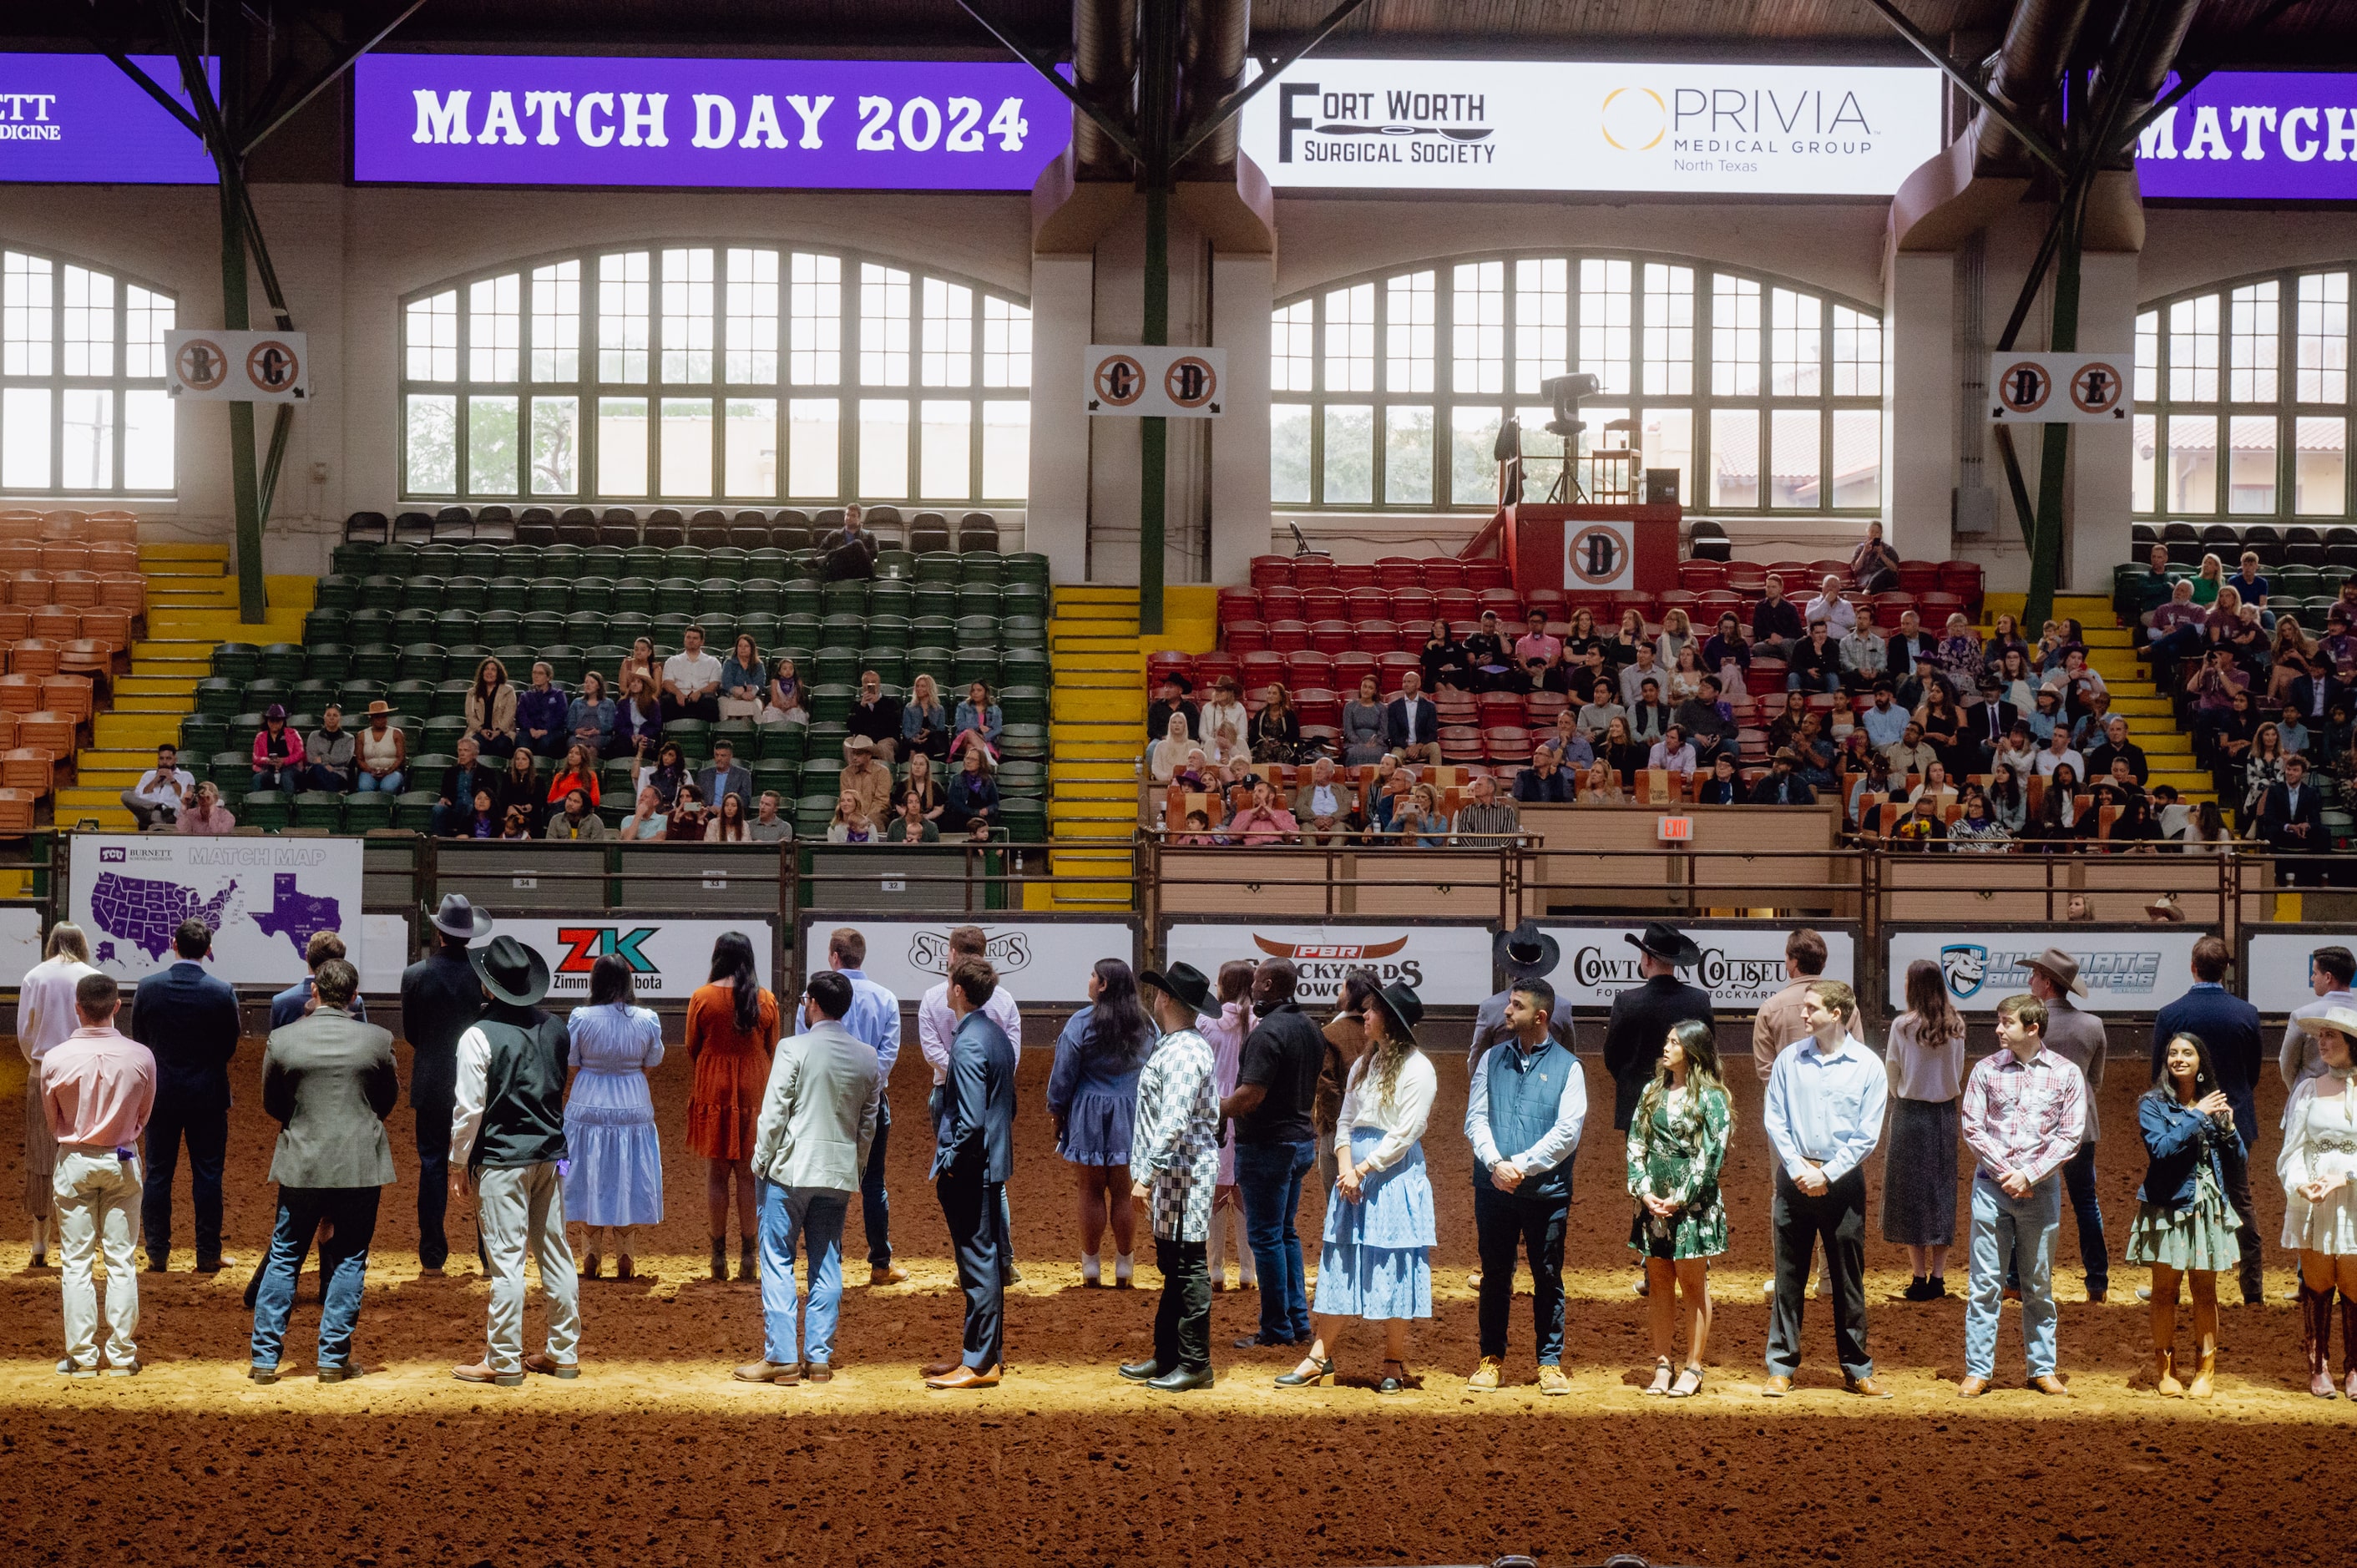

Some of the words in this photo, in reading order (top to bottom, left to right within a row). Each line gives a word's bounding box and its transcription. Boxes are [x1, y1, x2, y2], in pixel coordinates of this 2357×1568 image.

[412, 89, 669, 147] MATCH
[691, 93, 835, 149] DAY
[857, 95, 1029, 152] 2024
[1279, 83, 1374, 163] FORT
[1386, 90, 1485, 121] WORTH
[1675, 89, 1870, 134] PRIVIA
[1304, 140, 1403, 163] SURGICAL
[1411, 141, 1496, 164] SOCIETY
[1674, 139, 1778, 153] MEDICAL
[1792, 140, 1871, 154] GROUP
[1674, 159, 1712, 172] North
[1718, 159, 1758, 172] Texas
[191, 346, 214, 382] B
[264, 349, 284, 385] C
[1110, 362, 1130, 398] C
[1181, 365, 1202, 400] D
[2015, 370, 2038, 405] D
[2086, 372, 2106, 403] E
[1587, 534, 1613, 576] D
[1665, 819, 1688, 837] EXIT
[102, 849, 124, 861] TCU
[189, 847, 270, 866] MATCH
[275, 848, 326, 867] MAP
[554, 928, 661, 973] ZK
[1297, 946, 1358, 957] PBR
